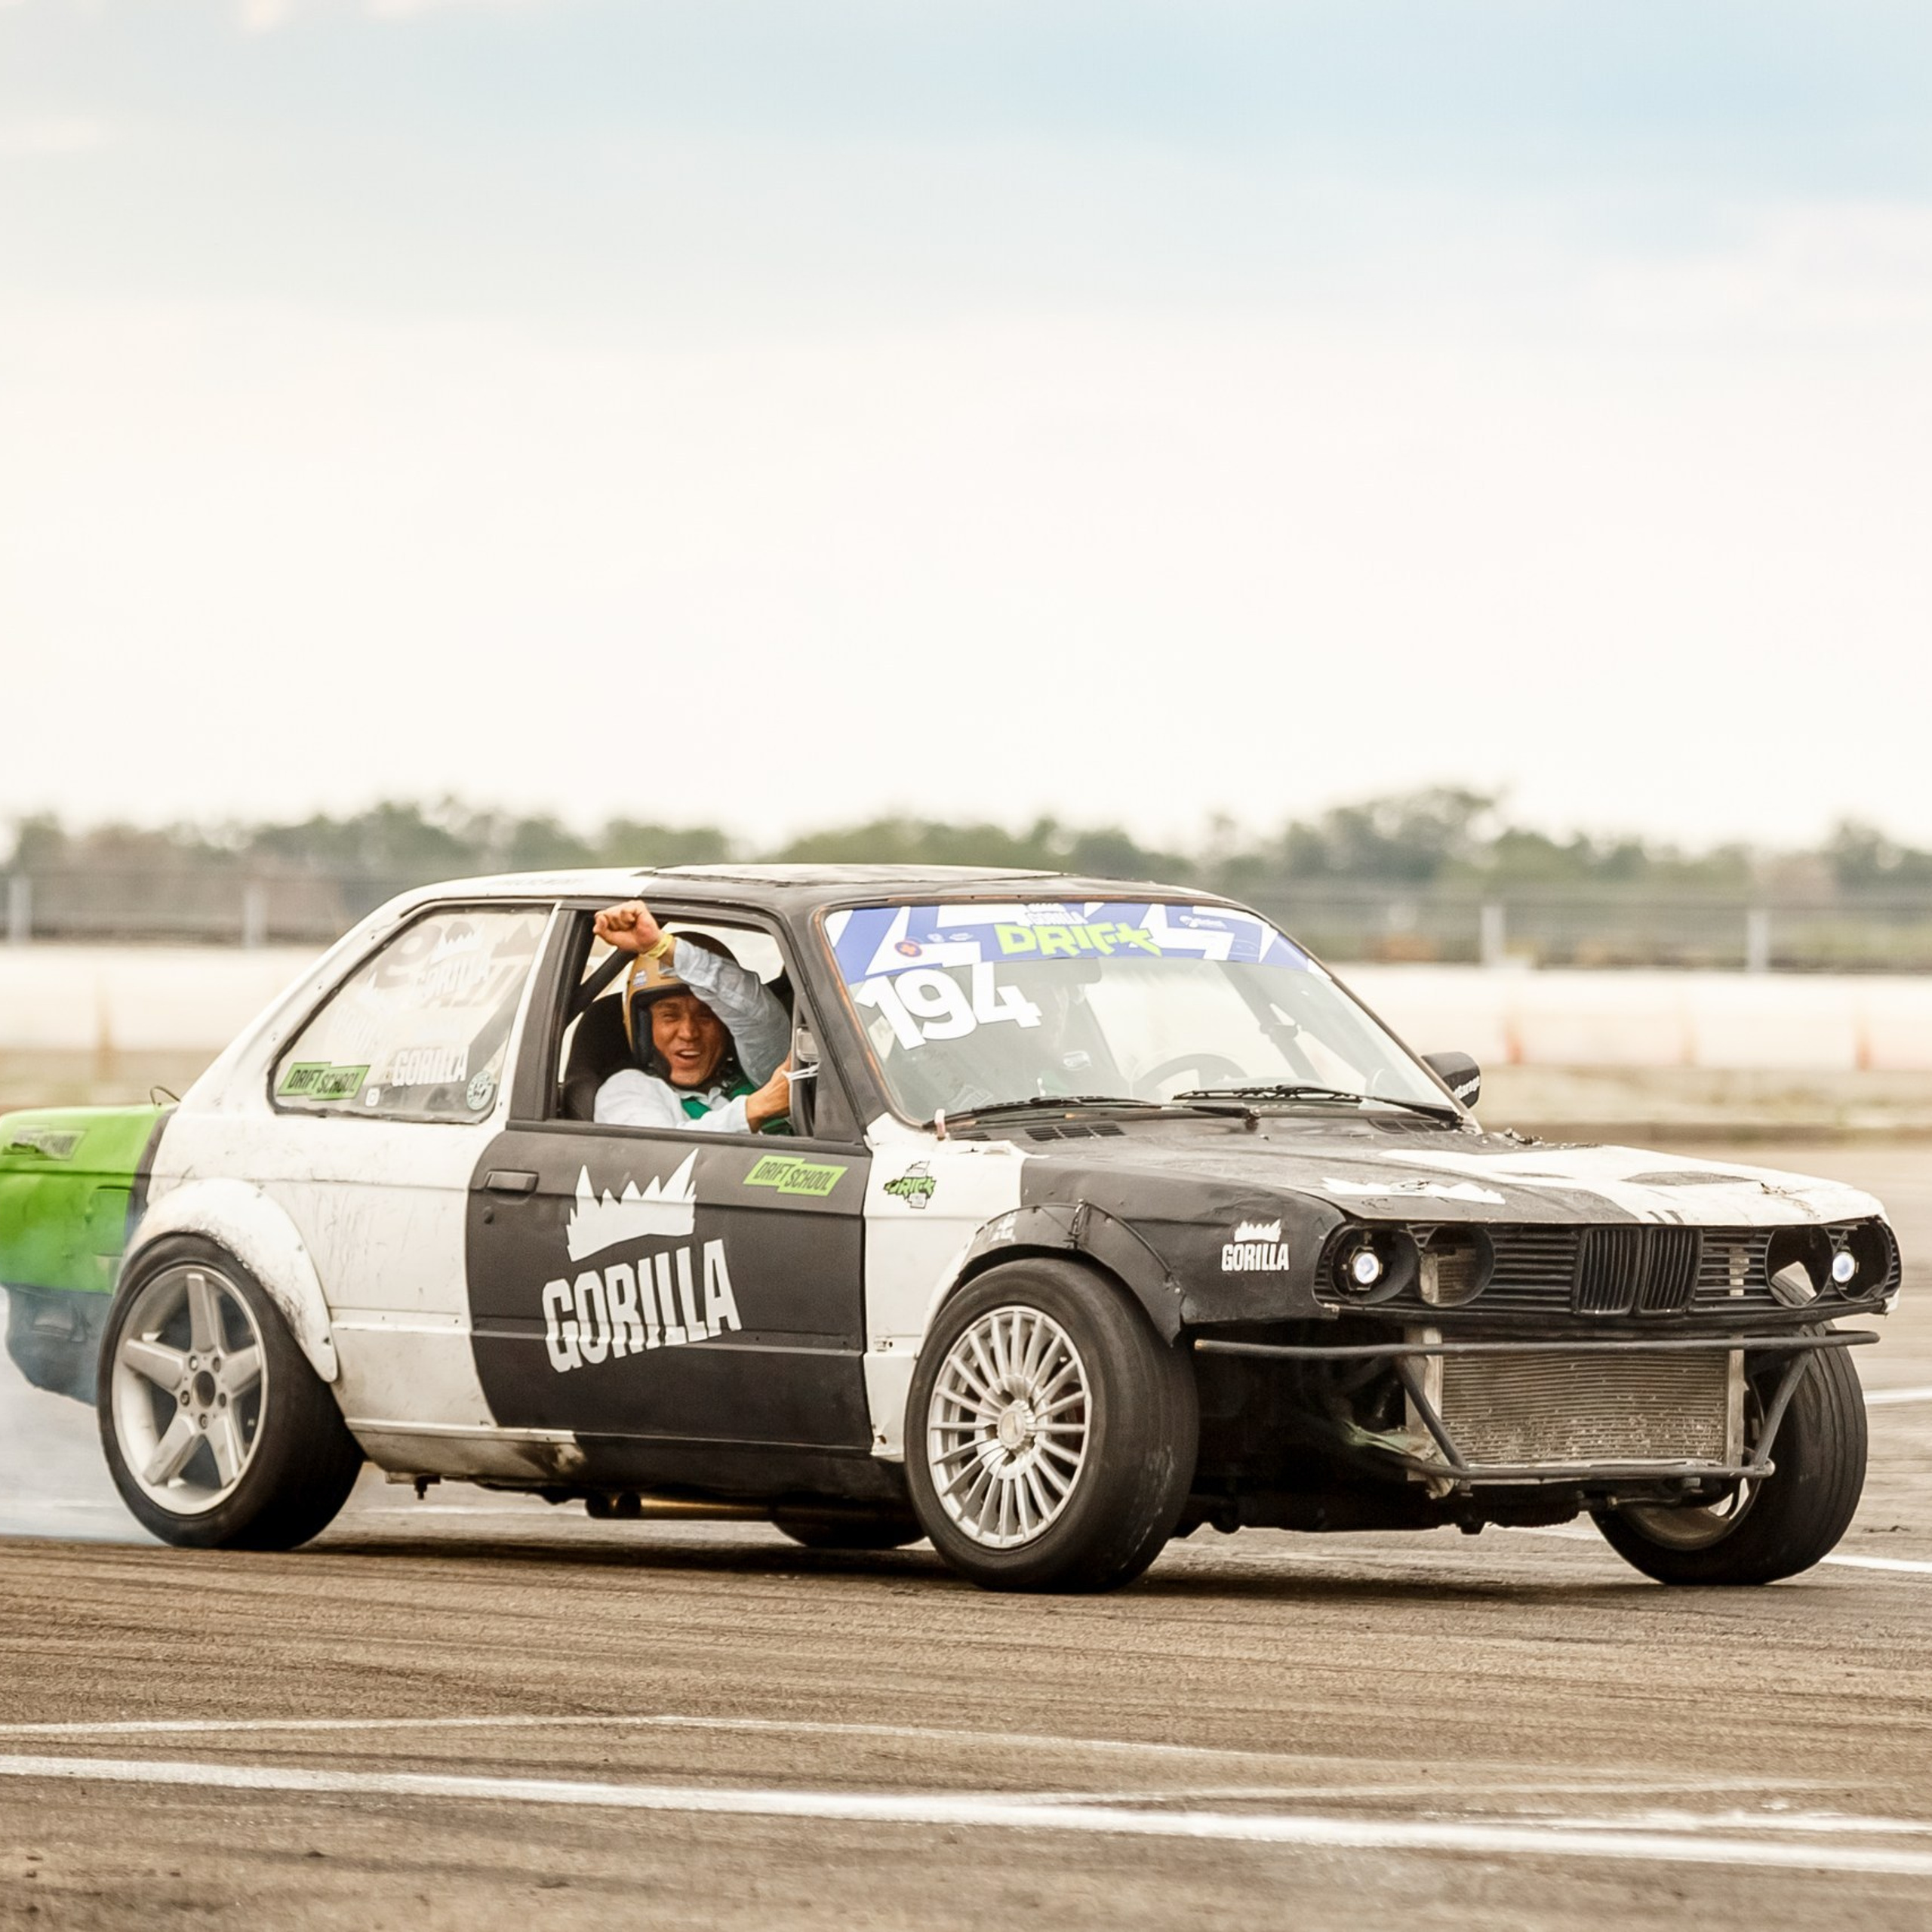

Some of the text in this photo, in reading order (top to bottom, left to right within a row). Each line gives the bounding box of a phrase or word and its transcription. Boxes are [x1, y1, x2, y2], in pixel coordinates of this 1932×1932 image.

[993, 922, 1163, 958] DRIFT
[855, 961, 1042, 1051] 194
[286, 1069, 360, 1094] DRIFT SCHOOL
[391, 1046, 469, 1088] GORILLA
[753, 1161, 835, 1191] DRIFT SCHOOL
[1222, 1243, 1290, 1272] GORILLA
[542, 1238, 742, 1374] GORILLA
